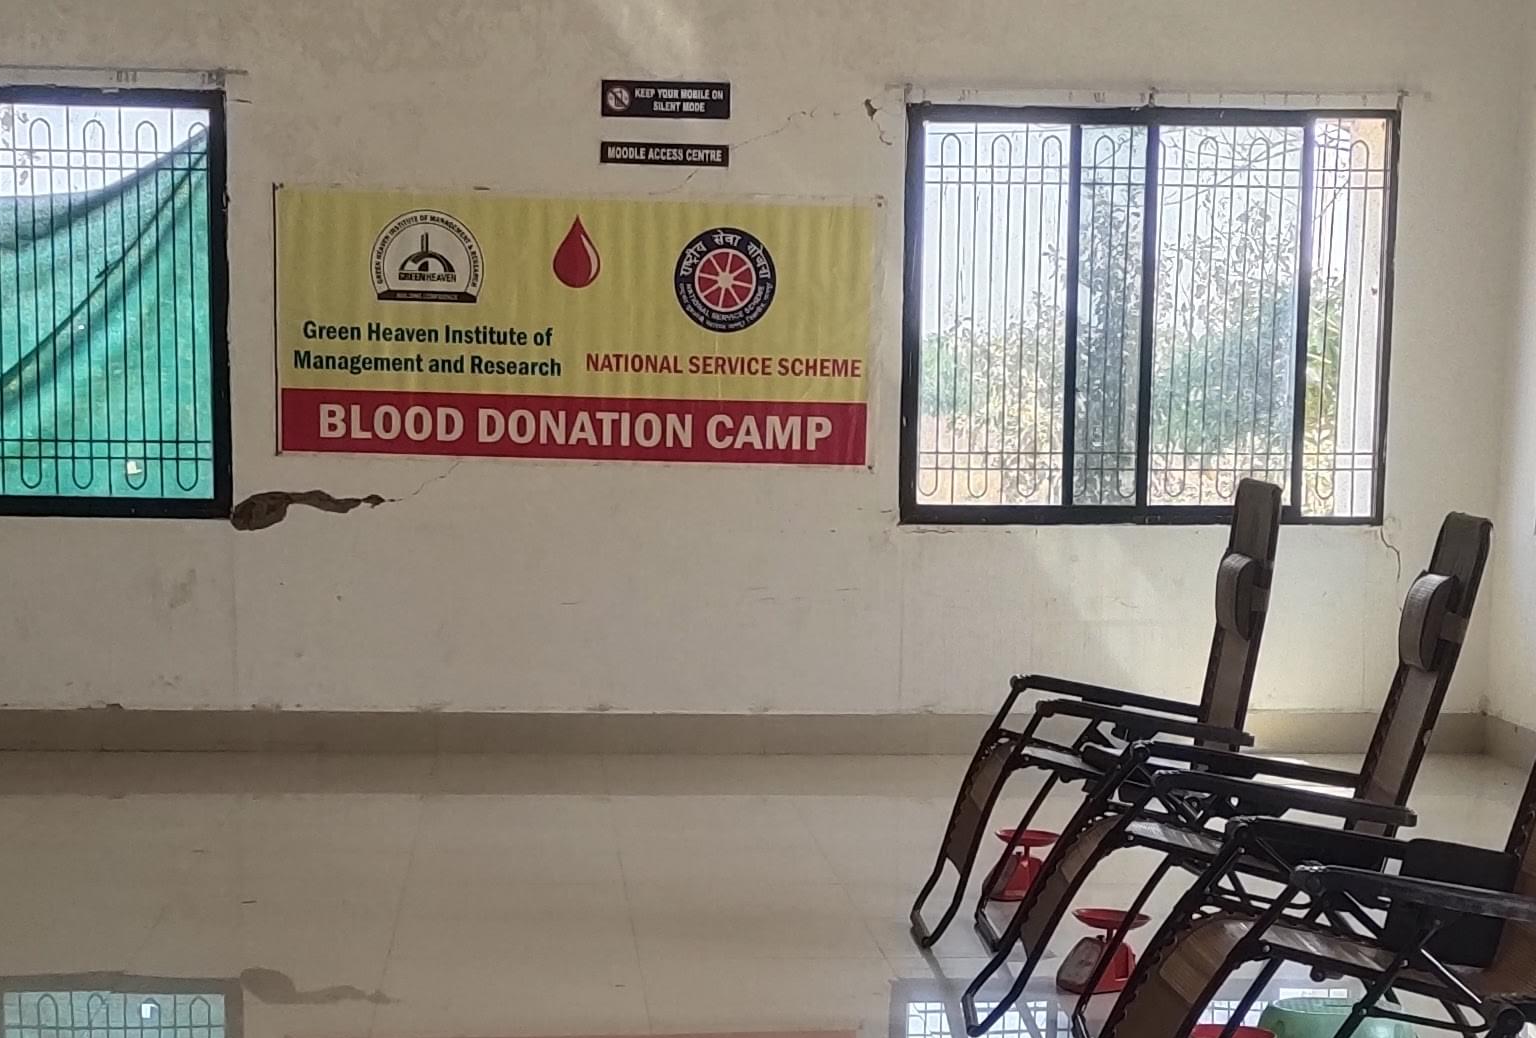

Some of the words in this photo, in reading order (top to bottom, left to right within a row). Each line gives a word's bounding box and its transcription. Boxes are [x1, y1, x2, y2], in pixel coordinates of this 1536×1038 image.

[634, 88, 656, 98] KEEP
[657, 88, 679, 99] YOUR
[680, 89, 710, 100] MOBILE
[711, 90, 724, 100] ON
[653, 101, 681, 112] SILENT
[682, 102, 705, 112] MODE
[607, 146, 646, 160] MOODLE
[648, 147, 684, 161] ACCESS
[685, 148, 723, 163] CENTRE
[679, 241, 708, 277] राष्ट्रीय
[712, 229, 743, 247] सेवा
[747, 241, 771, 279] योजना
[302, 320, 362, 341] Green
[367, 322, 439, 344] Heaven
[445, 324, 528, 346] Institute
[533, 327, 553, 346] of
[293, 349, 424, 375] Management
[428, 354, 465, 374] and
[470, 355, 562, 377] Research
[585, 352, 683, 375] NATIONAL
[688, 355, 773, 376] SERVICE
[777, 357, 862, 378] SCHEME
[319, 403, 464, 442] BLOOD
[477, 407, 693, 449] DONATION
[706, 413, 833, 451] CAMP
